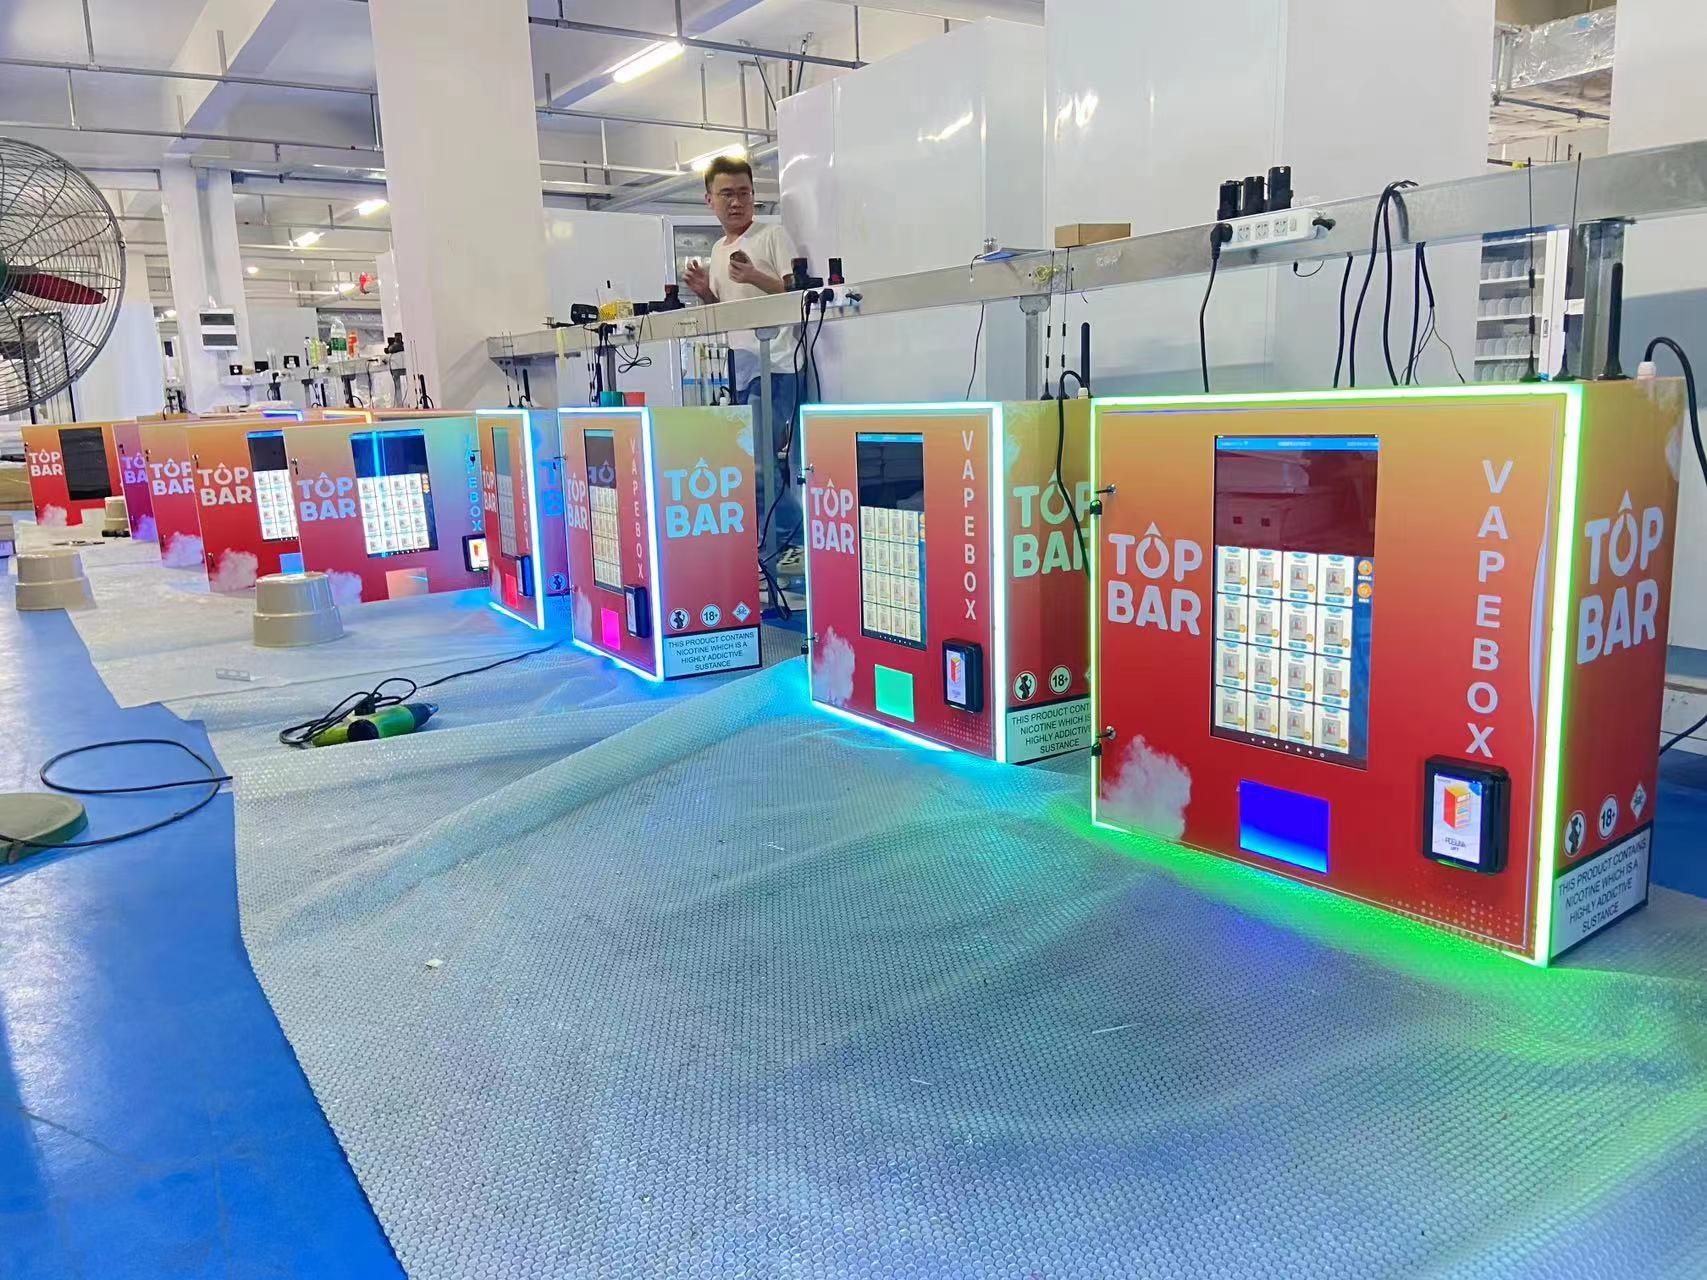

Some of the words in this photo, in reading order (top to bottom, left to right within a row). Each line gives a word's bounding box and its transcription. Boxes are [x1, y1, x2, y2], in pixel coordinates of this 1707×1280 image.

[30, 464, 63, 476] BAR
[124, 470, 148, 484] BA
[200, 486, 252, 506] BAR
[300, 498, 356, 521] BAR
[567, 503, 588, 530] BAR
[666, 502, 744, 538] BAR
[811, 520, 855, 554] BAR
[1108, 580, 1201, 636] BAR
[1577, 579, 1659, 665] BAR
[668, 641, 684, 649] THIS
[685, 636, 719, 646] PRODUCT
[721, 632, 755, 642] CONTAINS
[676, 646, 709, 656] NICOTINE
[711, 644, 734, 652] WHICH
[681, 656, 706, 664] HIGHLY
[707, 650, 743, 661] ADDICTIVE
[694, 660, 731, 671] SUSTANCE
[1052, 674, 1068, 688] 18+
[1012, 714, 1029, 725] THIS
[1031, 707, 1068, 720] PRODUCT
[1020, 720, 1057, 735] NICOTINE
[1058, 716, 1083, 727] WHICH
[1025, 733, 1053, 746] HIGHLY
[1040, 738, 1080, 754] SUSTANCE
[1601, 808, 1616, 830] 18+
[1558, 879, 1576, 897] THIS
[1576, 857, 1612, 886] PRODUCT
[1612, 838, 1647, 867] CONTAINS
[1565, 882, 1602, 909] NICOTINE
[1602, 866, 1626, 892] WHICH
[1625, 863, 1633, 877] IS
[1569, 901, 1596, 925] HIGHLY
[1596, 877, 1633, 909] ADDICTIVE
[1581, 901, 1620, 934] SUSTANCE
